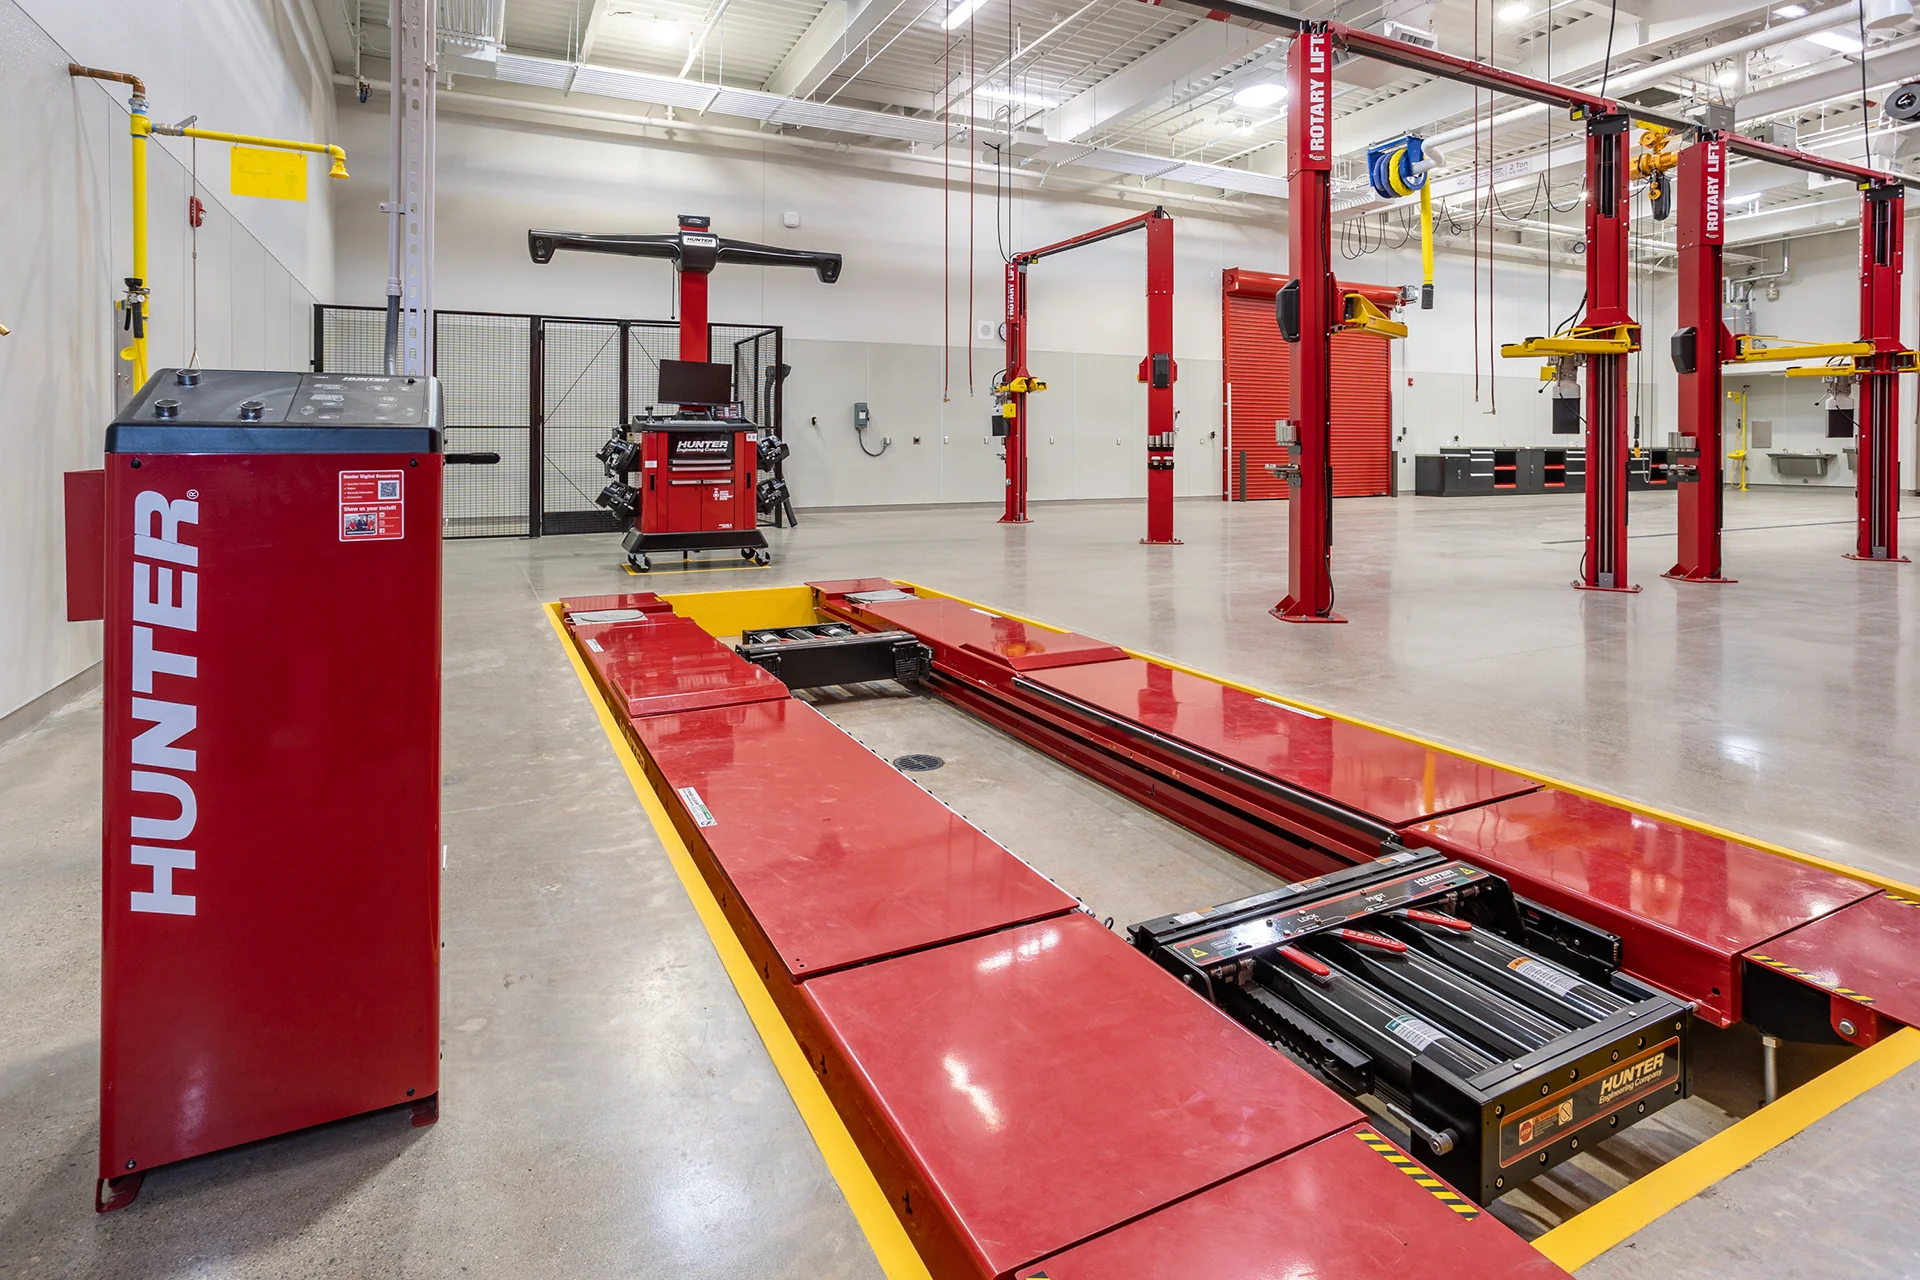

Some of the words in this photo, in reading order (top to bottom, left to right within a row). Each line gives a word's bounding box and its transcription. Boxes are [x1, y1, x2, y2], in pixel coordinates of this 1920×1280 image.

[1310, 35, 1324, 73] LIFT
[1310, 78, 1324, 150] ROTARY
[1516, 160, 1528, 168] Ton
[1708, 142, 1720, 172] LIFT
[1706, 176, 1719, 231] ROTARY
[1414, 870, 1454, 885] HUNTER
[1297, 914, 1320, 923] LOCK
[1599, 1081, 1634, 1104] Engineering
[1634, 1068, 1663, 1088] Company
[1600, 1052, 1664, 1095] HUNTER
[1520, 1126, 1531, 1137] STOP
